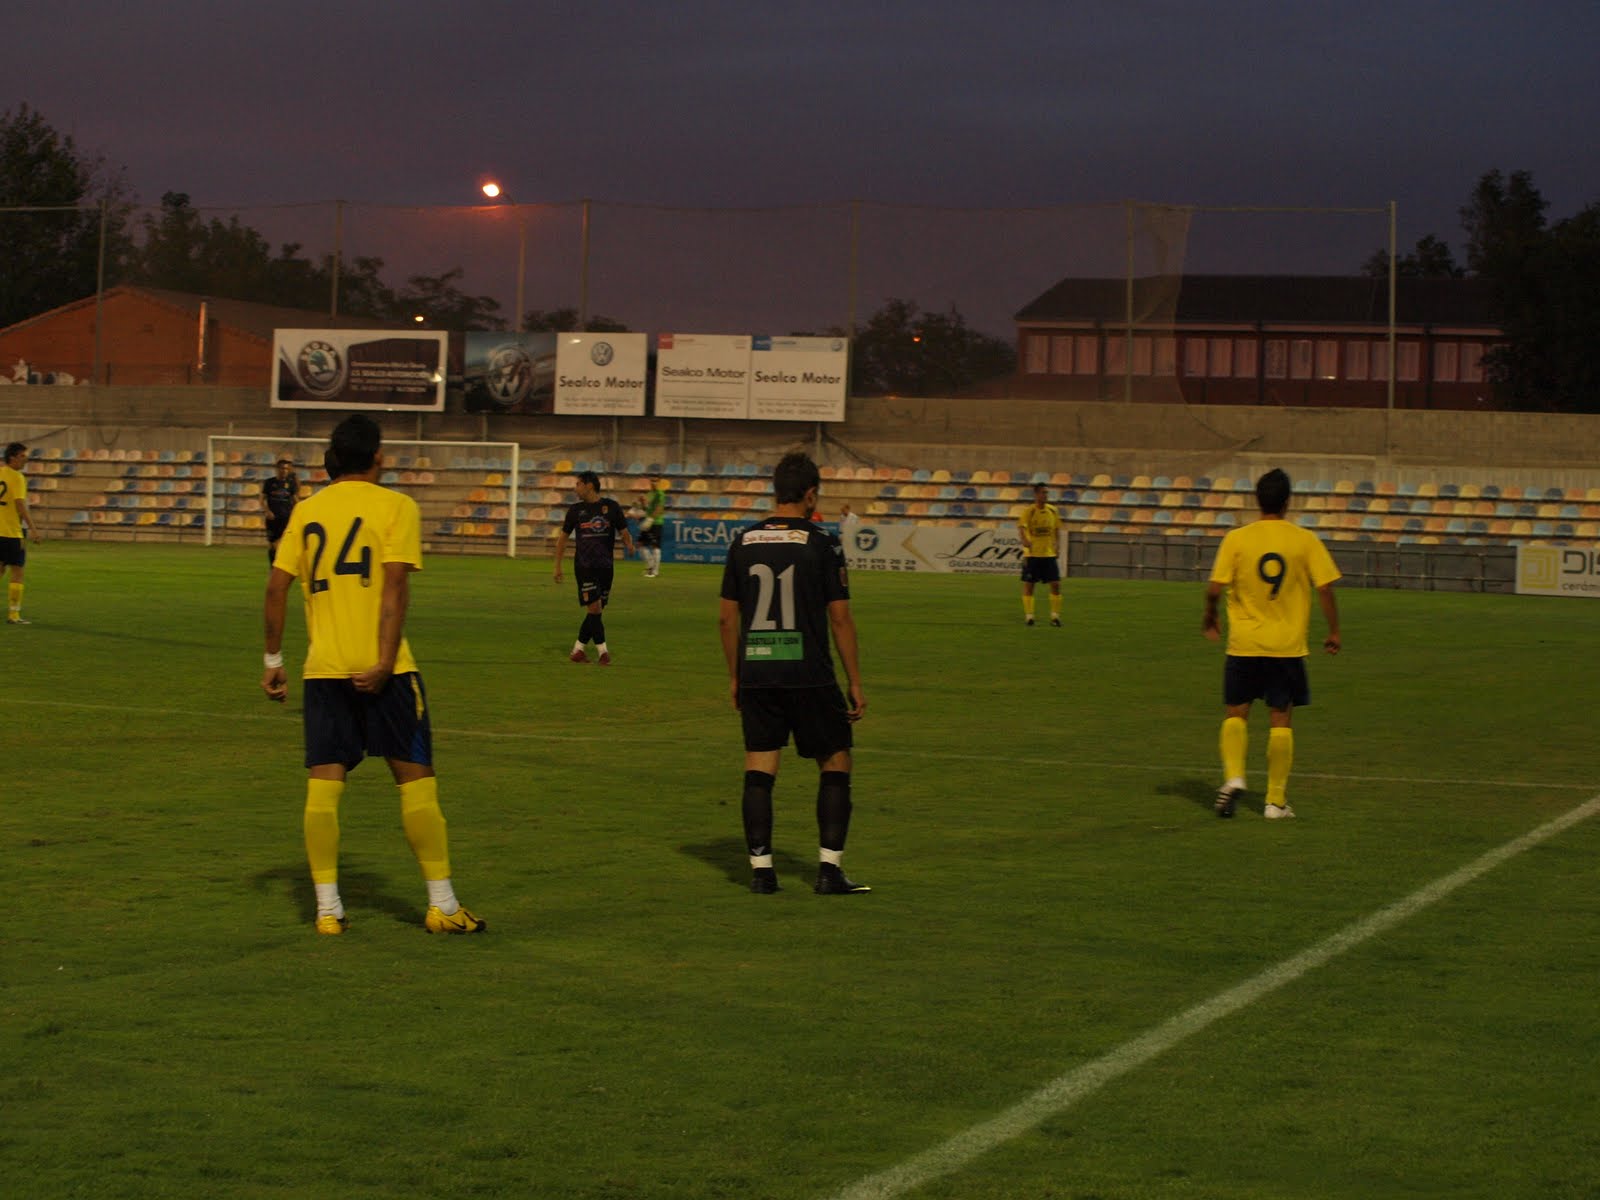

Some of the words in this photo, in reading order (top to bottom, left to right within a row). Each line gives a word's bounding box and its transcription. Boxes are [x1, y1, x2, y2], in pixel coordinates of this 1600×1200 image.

[559, 375, 601, 388] Sealco
[605, 376, 644, 389] Motor
[662, 366, 703, 378] Sealco
[706, 367, 746, 379] Motor
[755, 371, 797, 383] Sealco
[802, 372, 841, 384] Motor
[303, 516, 371, 594] 24
[1563, 550, 1600, 575] DI
[1258, 552, 1285, 601] 9
[748, 563, 796, 630] 21
